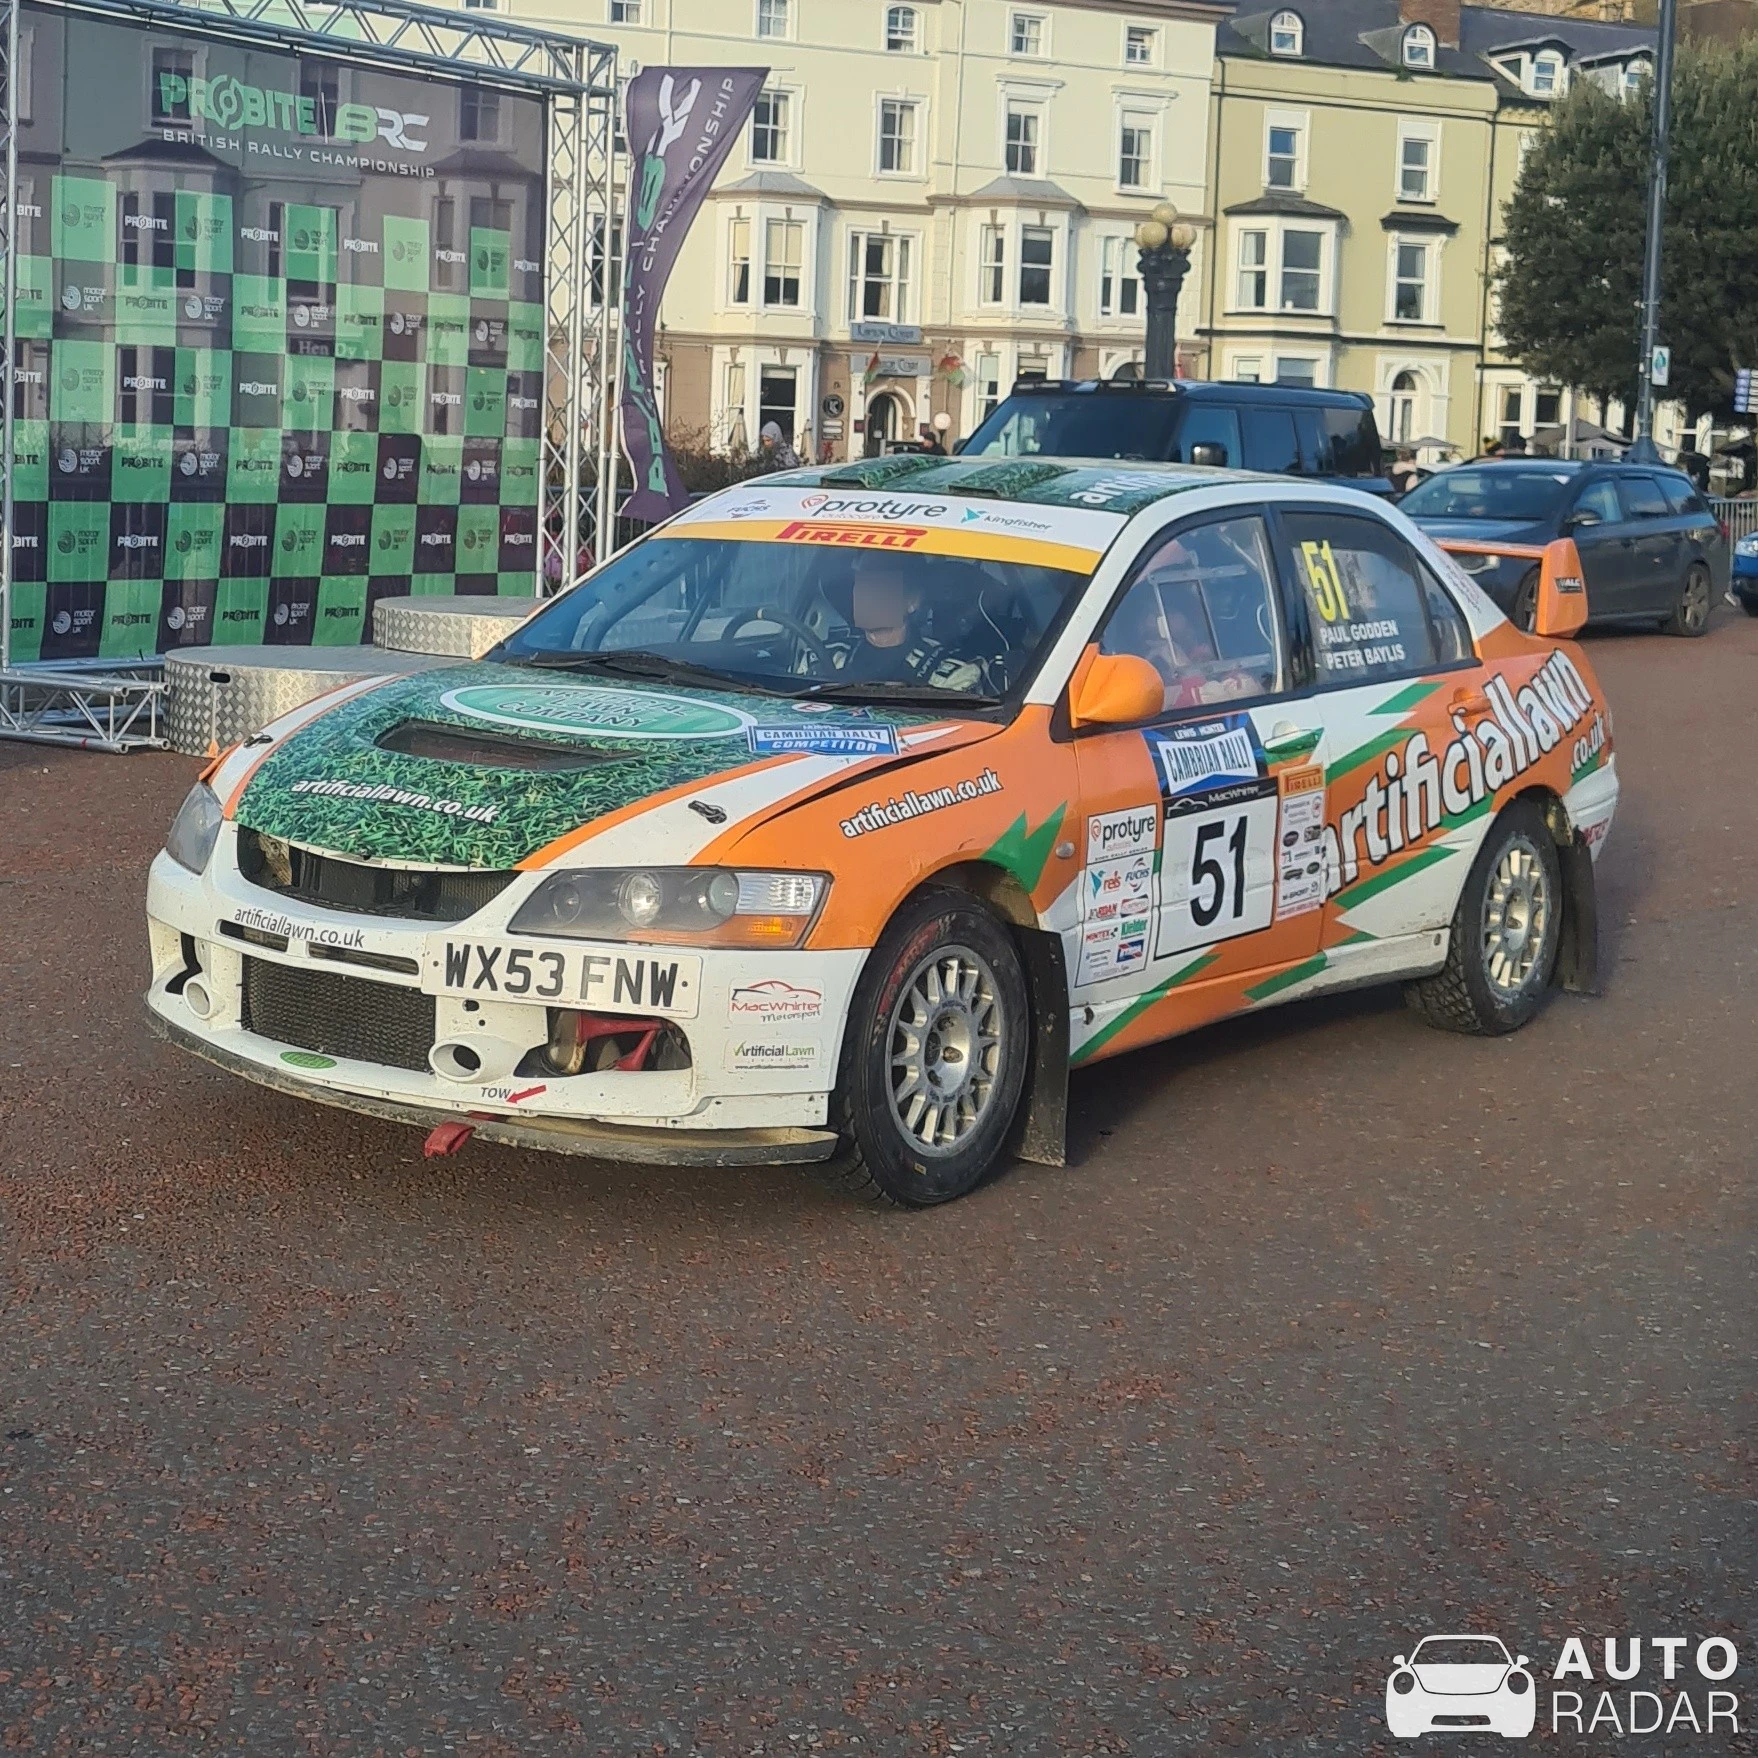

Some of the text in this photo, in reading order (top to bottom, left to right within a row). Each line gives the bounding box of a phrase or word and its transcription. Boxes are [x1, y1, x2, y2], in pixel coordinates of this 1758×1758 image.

[159, 73, 429, 151] PROBITE BRC
[163, 129, 436, 178] BRITISH RALLY CHAMPIONSHIP
[124, 214, 168, 230] PROBITE
[240, 227, 278, 242] PROBITE
[343, 238, 379, 253] PROBITE
[125, 296, 168, 310] PROBITE
[123, 375, 167, 390] PROBITE
[239, 380, 277, 396] PROBITE
[340, 386, 375, 401] PROBITE
[80, 456, 101, 466] sport
[121, 455, 163, 470] PROBITE
[80, 465, 90, 474] UK
[811, 499, 948, 520] protyre
[117, 534, 159, 549] PROBITE
[230, 533, 268, 548] PROBITE
[330, 533, 365, 547] PROBITE
[775, 521, 927, 548] PIRELLI
[1300, 539, 1349, 622] 51
[187, 613, 205, 622] sport
[188, 606, 208, 614] motor
[222, 609, 260, 622] PROBITE
[324, 606, 360, 619] PROBITE
[73, 616, 93, 626] sport
[111, 612, 151, 627] PROBITE
[185, 621, 194, 629] UK
[72, 625, 81, 634] UK
[1319, 619, 1399, 646] PAUL GODDEN
[1325, 643, 1406, 670] PETER BAYLIS
[551, 698, 643, 715] LAWN
[497, 701, 653, 728] COMPANY
[763, 730, 883, 740] CAMBRIAN RALLY
[771, 739, 878, 752] COMPETITOR
[1165, 734, 1251, 783] CAMBRIAN RALLY
[291, 778, 501, 824] artificiallawn.co.uk
[839, 767, 1004, 838] artificiallawn.co.uk
[1102, 815, 1155, 849] protyre
[1189, 815, 1249, 927] 51
[234, 907, 365, 949] artificiallawn.co.uk
[445, 942, 679, 1008] WX53 FNW
[731, 1001, 822, 1012] MacWhirter
[480, 1086, 512, 1099] TOW
